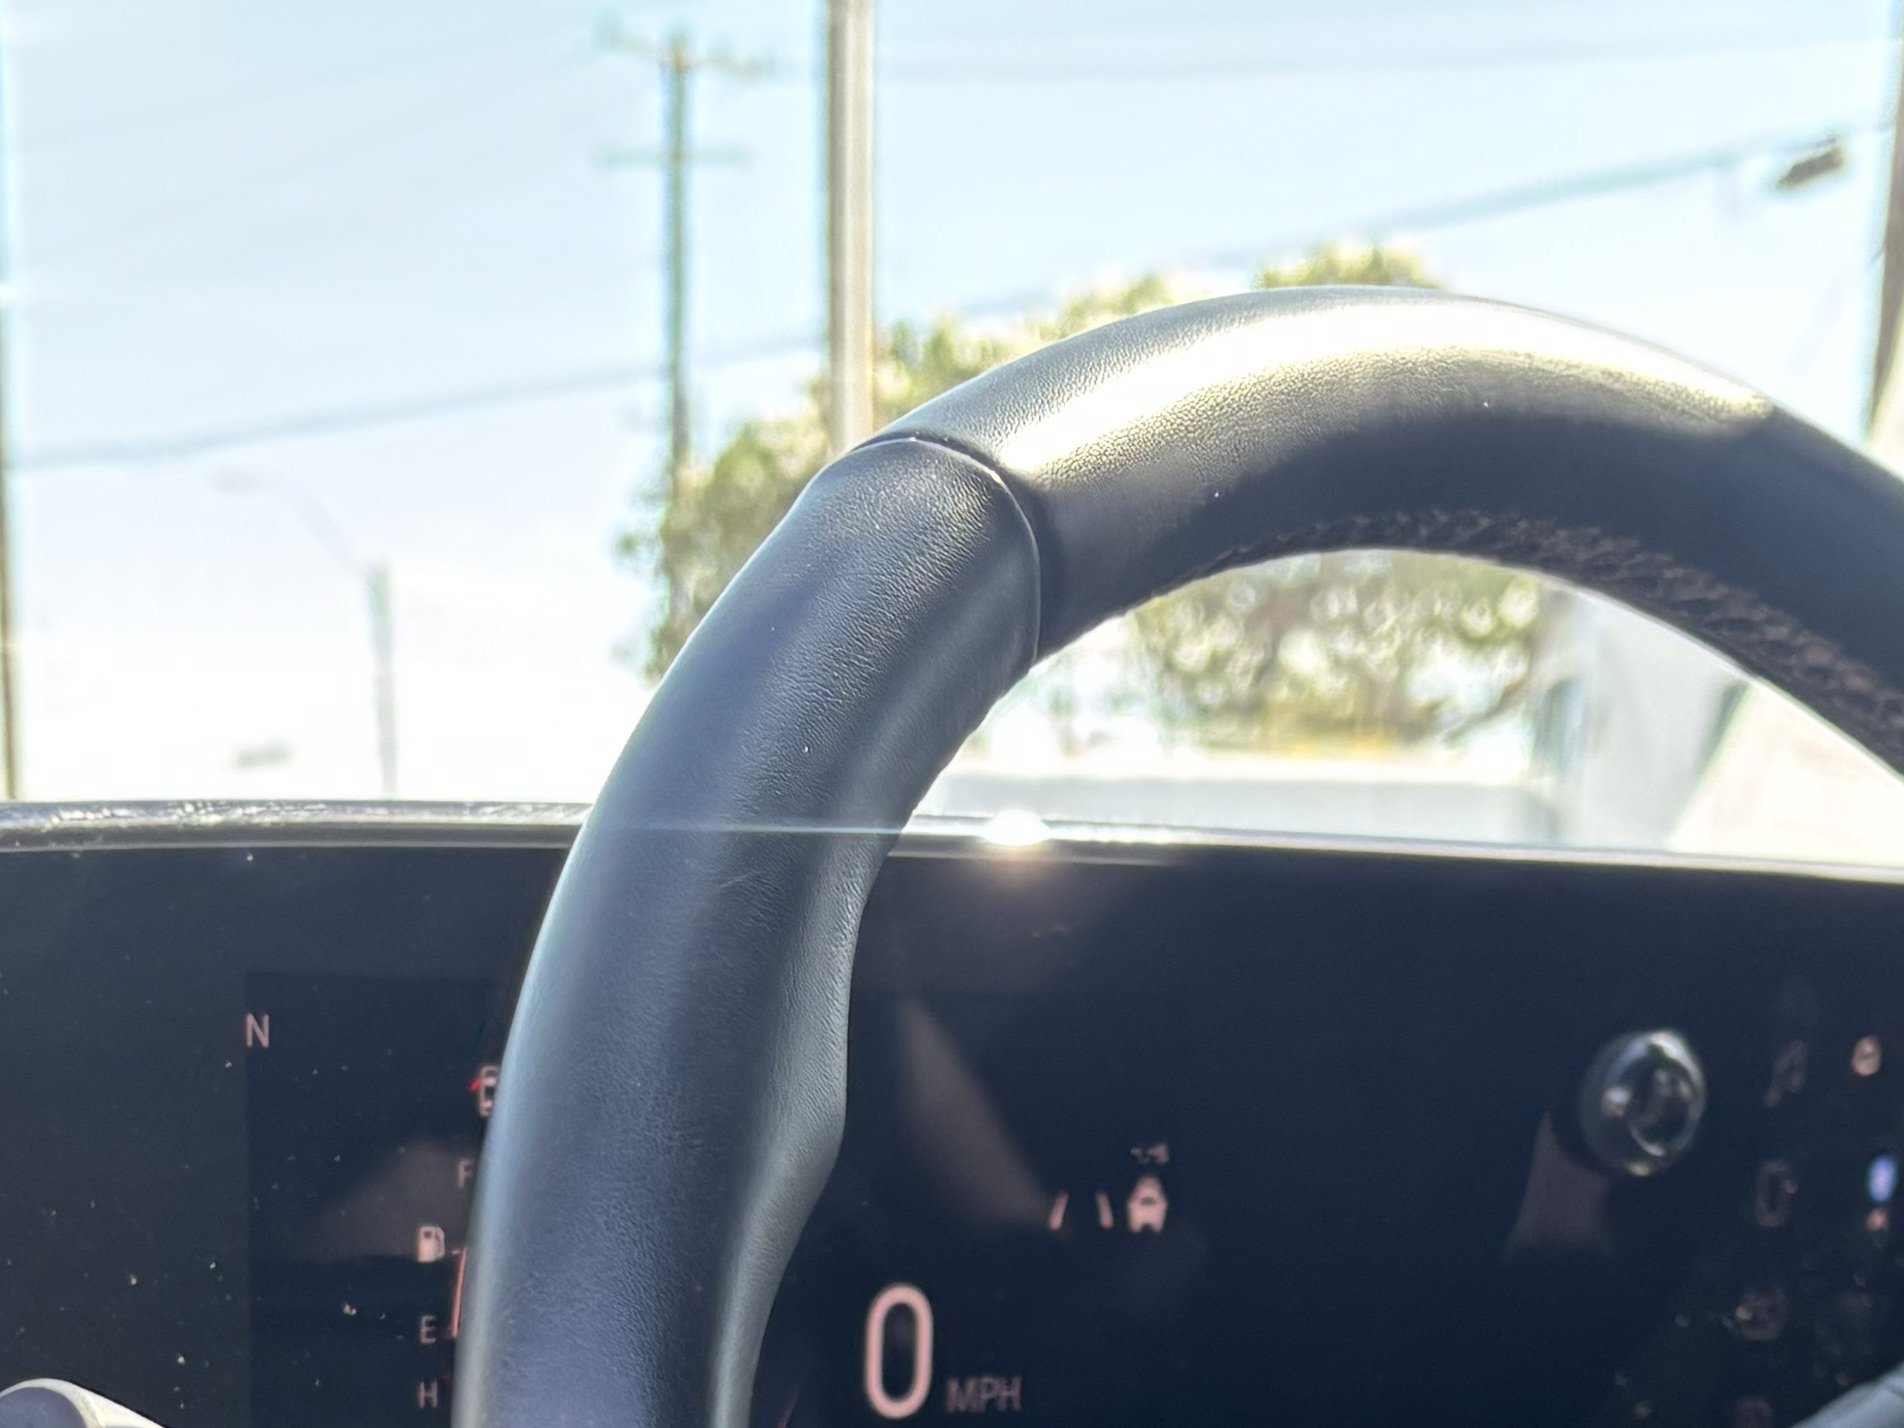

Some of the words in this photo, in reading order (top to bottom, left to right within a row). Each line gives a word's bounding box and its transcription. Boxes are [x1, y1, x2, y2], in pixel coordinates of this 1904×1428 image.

[246, 1012, 270, 1049] N
[419, 1314, 437, 1345] E
[864, 1282, 934, 1421] 0
[946, 1374, 1023, 1415] MPH
[417, 1381, 439, 1409] H
